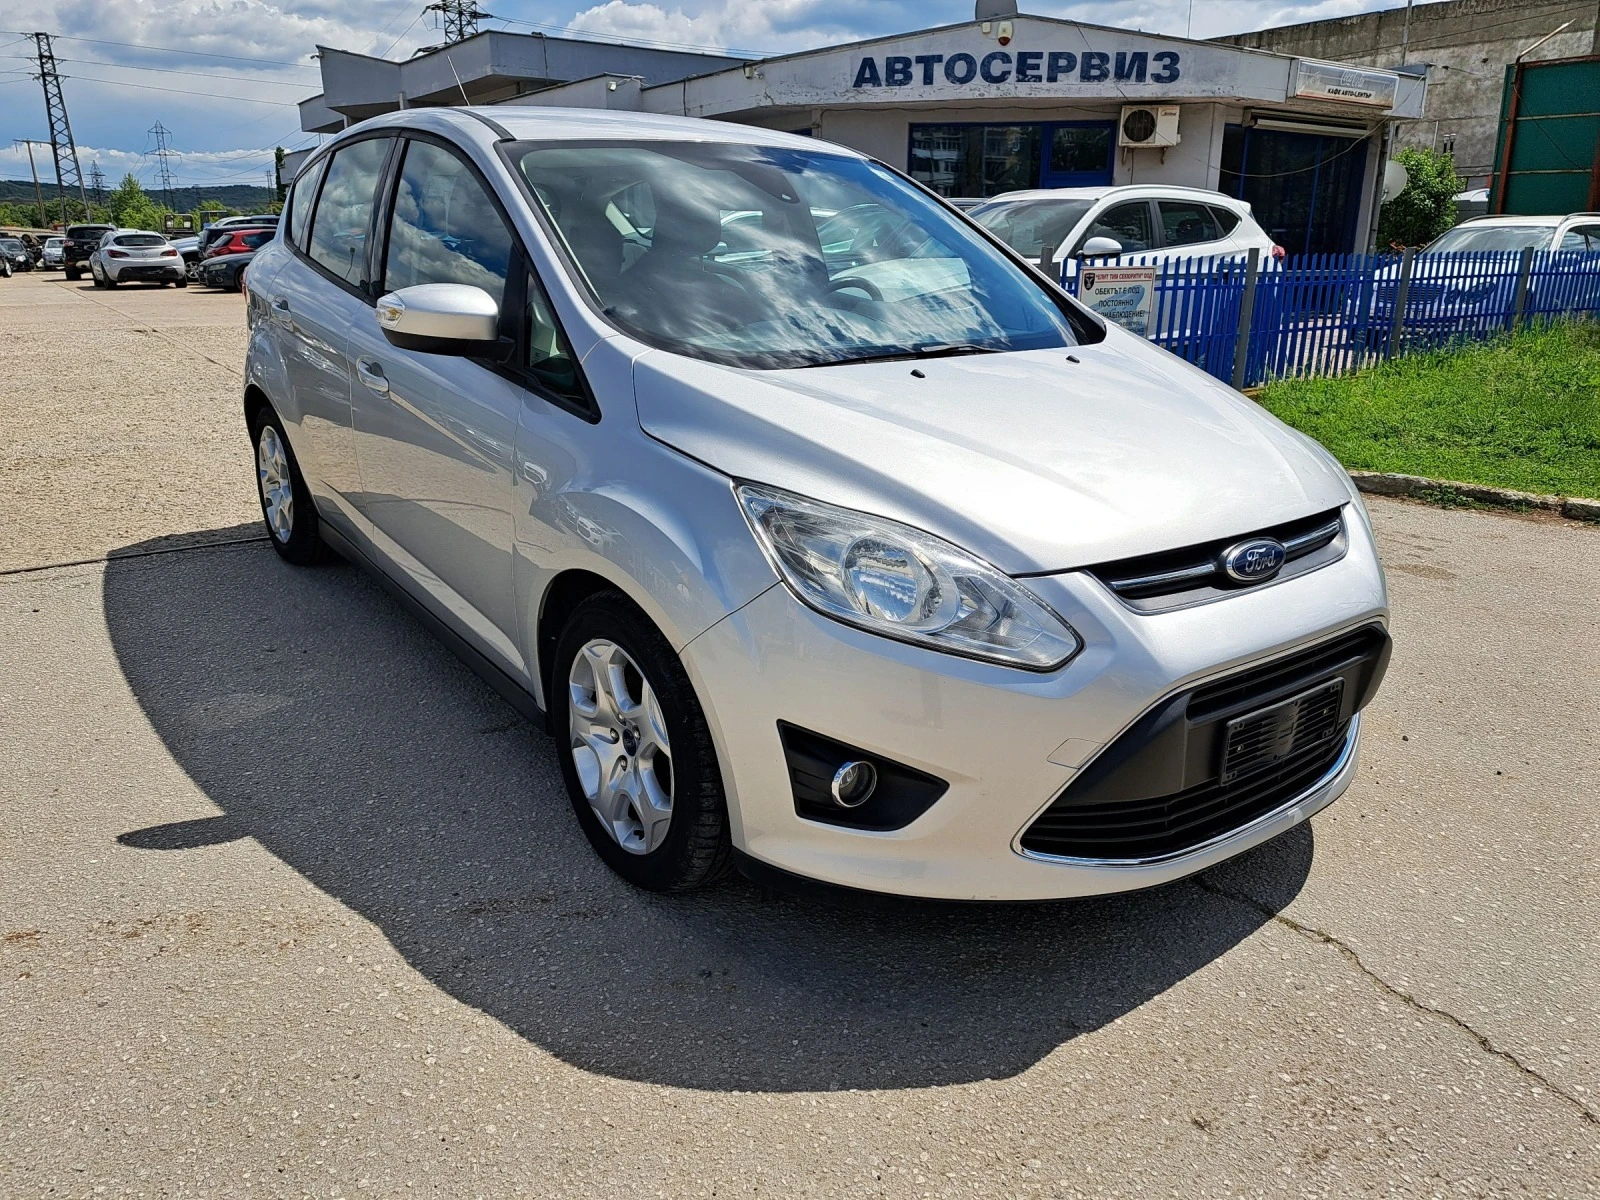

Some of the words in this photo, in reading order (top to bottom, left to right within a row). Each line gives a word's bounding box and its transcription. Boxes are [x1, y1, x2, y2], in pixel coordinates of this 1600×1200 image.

[852, 51, 1181, 88] АВТОСЕРВИЗ
[1095, 287, 1121, 295] ОБЕКТЪТ
[1127, 286, 1140, 294] ПОД
[1098, 299, 1134, 307] ПОСТОЯННО
[1245, 547, 1276, 573] Ford
